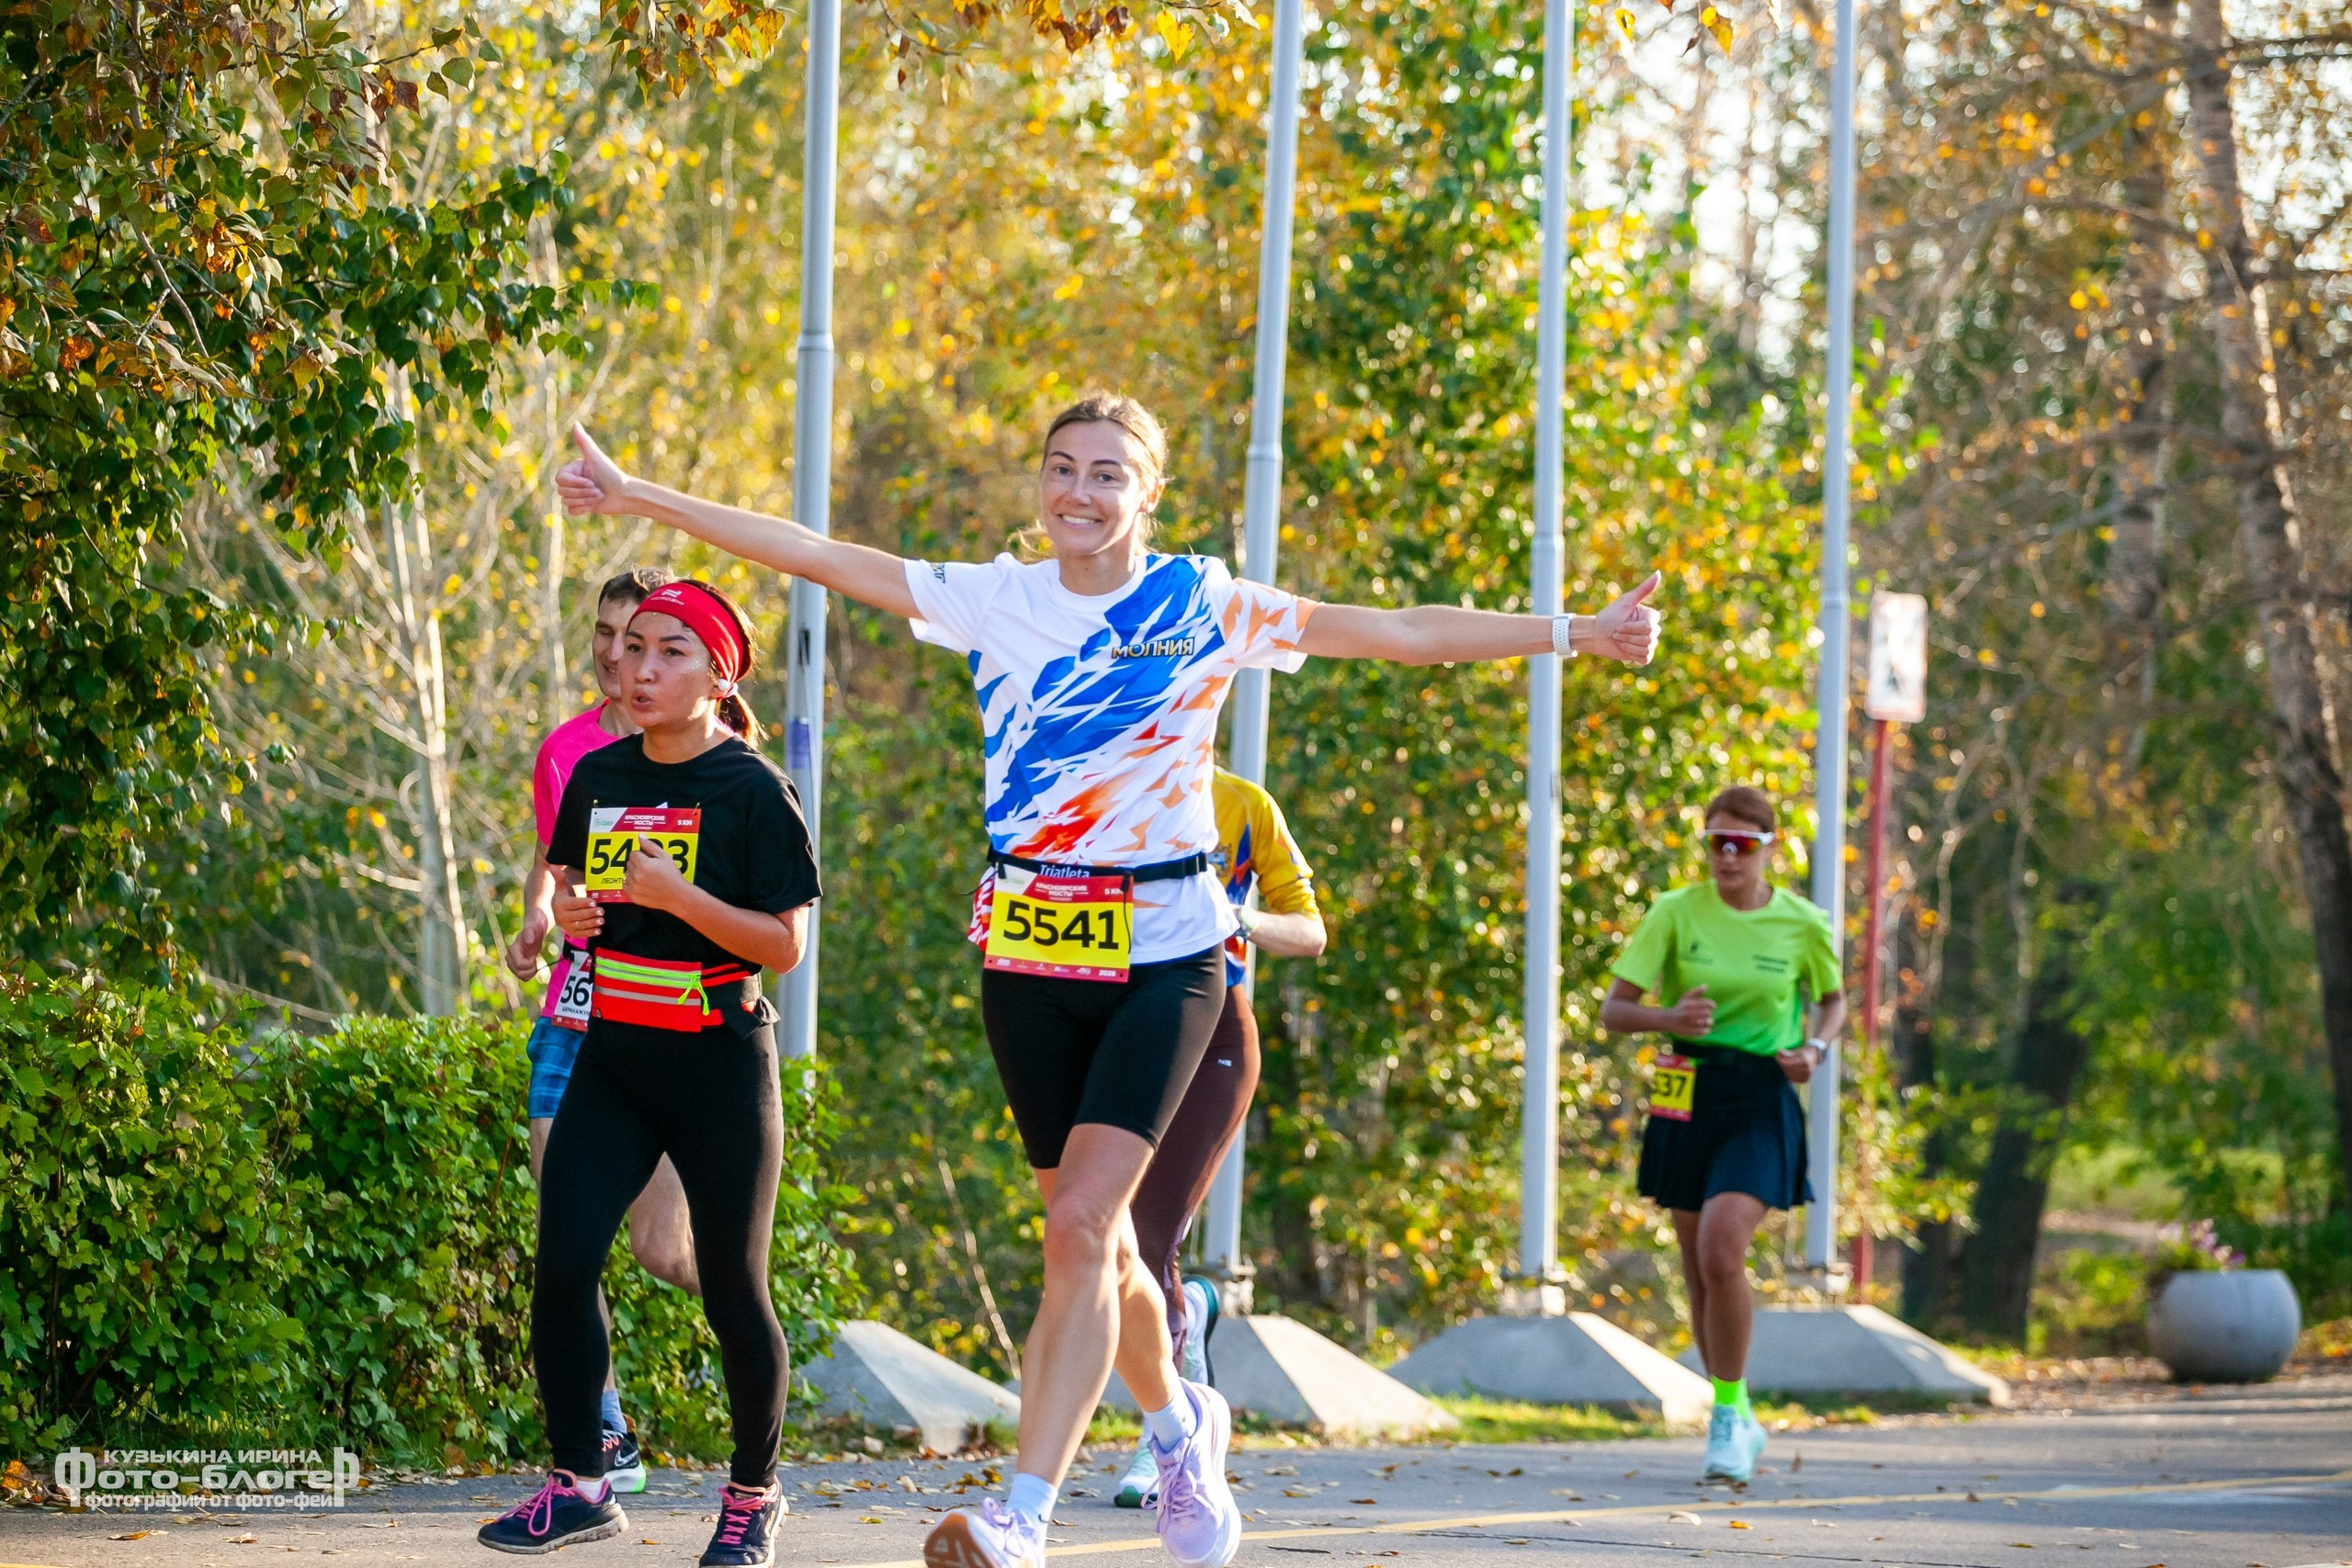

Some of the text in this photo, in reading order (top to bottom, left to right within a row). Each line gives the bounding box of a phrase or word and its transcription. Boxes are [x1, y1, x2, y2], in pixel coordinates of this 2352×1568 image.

[1111, 637, 1194, 660] МОЛНИЯ
[1040, 864, 1091, 878] Triatleta
[1002, 899, 1119, 951] 5541
